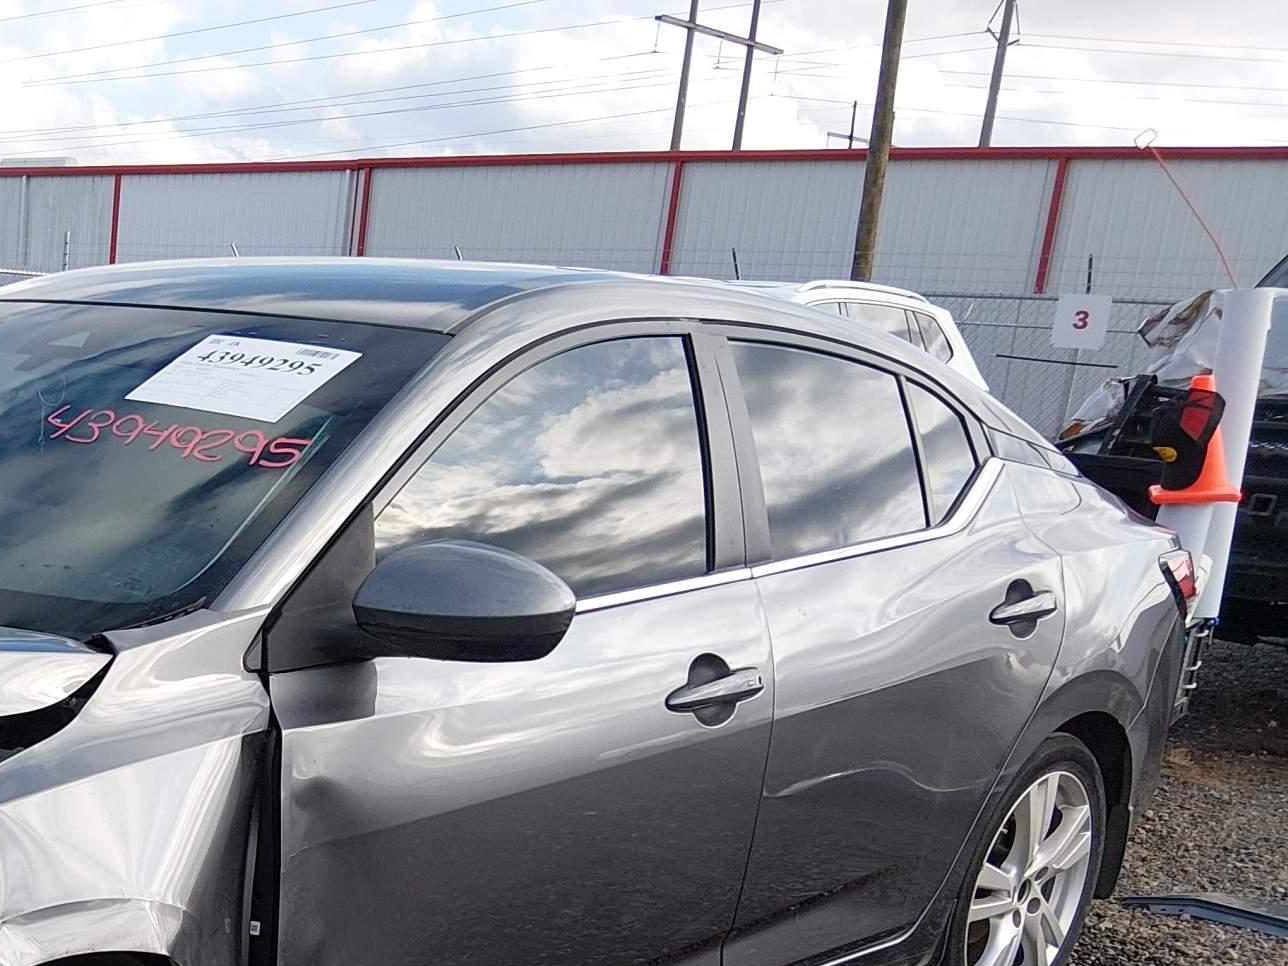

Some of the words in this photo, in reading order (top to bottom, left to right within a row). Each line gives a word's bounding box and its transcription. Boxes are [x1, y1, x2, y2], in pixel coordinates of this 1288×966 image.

[1073, 310, 1089, 330] 3
[197, 350, 324, 376] 43949295
[47, 404, 313, 468] 43949295
